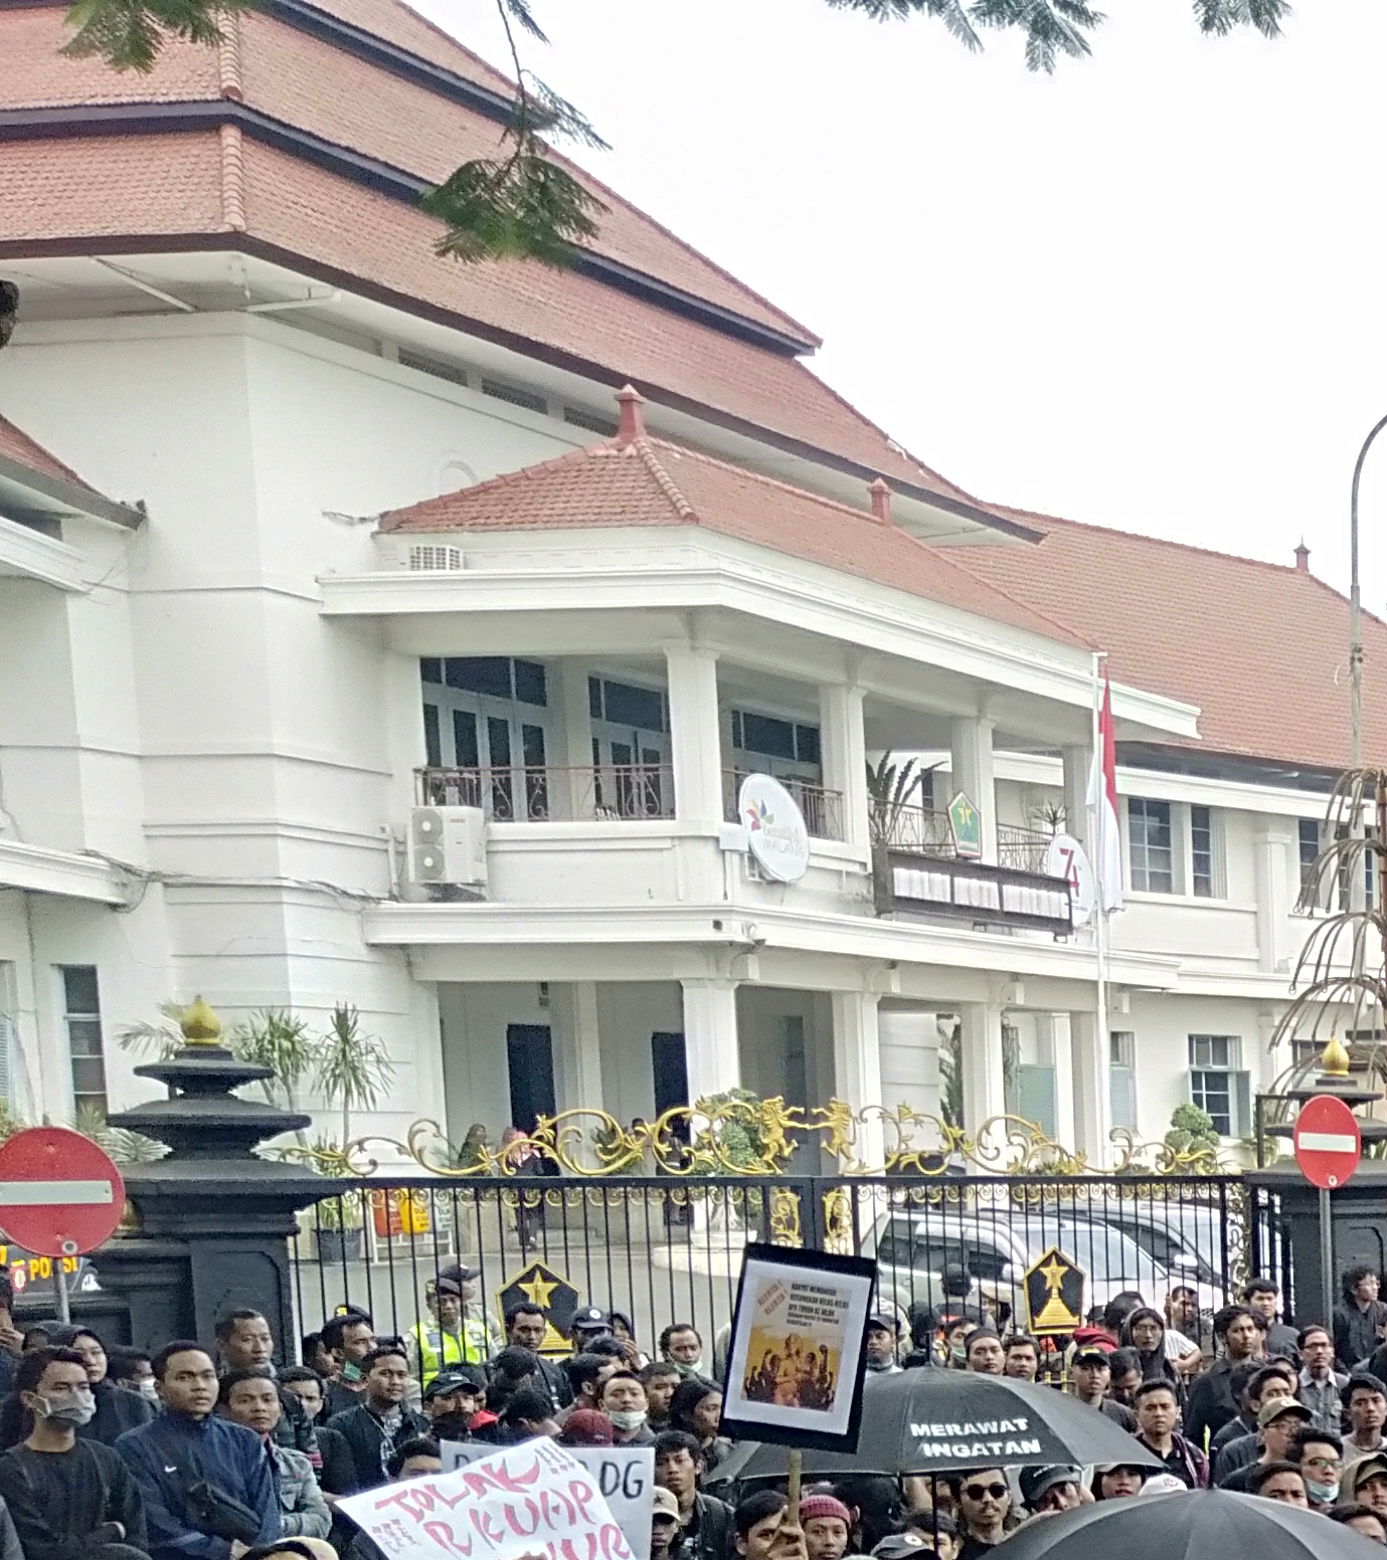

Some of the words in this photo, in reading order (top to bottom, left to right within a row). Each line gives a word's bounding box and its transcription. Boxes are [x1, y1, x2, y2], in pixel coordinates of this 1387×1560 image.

[29, 1255, 78, 1280] POSI
[910, 1418, 1028, 1437] MERAWAT
[923, 1439, 1042, 1458] INGATAN
[374, 1457, 541, 1524] TOLAK
